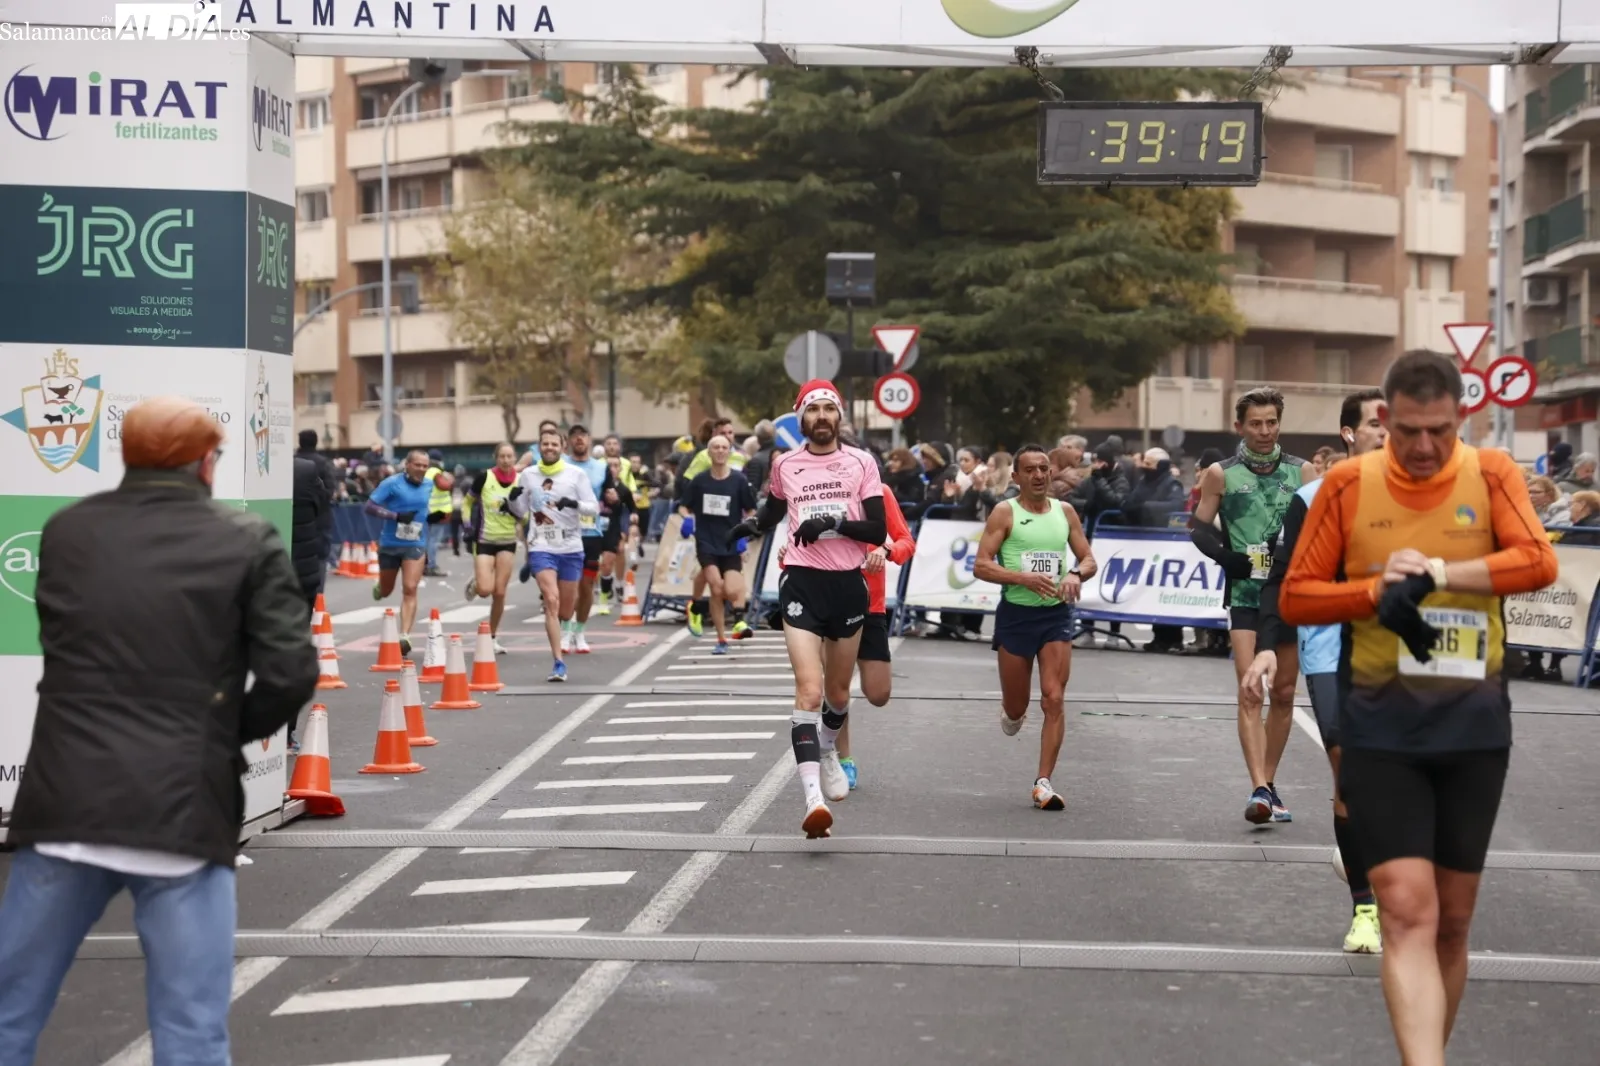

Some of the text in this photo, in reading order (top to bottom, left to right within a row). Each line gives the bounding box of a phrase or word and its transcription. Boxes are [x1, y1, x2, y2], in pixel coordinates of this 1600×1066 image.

[115, 121, 218, 141] fertilizantes
[37, 201, 194, 280] JRG
[140, 295, 194, 306] SOLUCIONES
[110, 306, 193, 317] VISUALES A MEDIDA
[884, 388, 909, 403] 30
[802, 481, 842, 493] CORRER
[793, 491, 852, 504] PARA COMER
[1031, 559, 1052, 573] 206
[1158, 591, 1221, 608] fertilizantes
[1506, 606, 1573, 630] Salamanca
